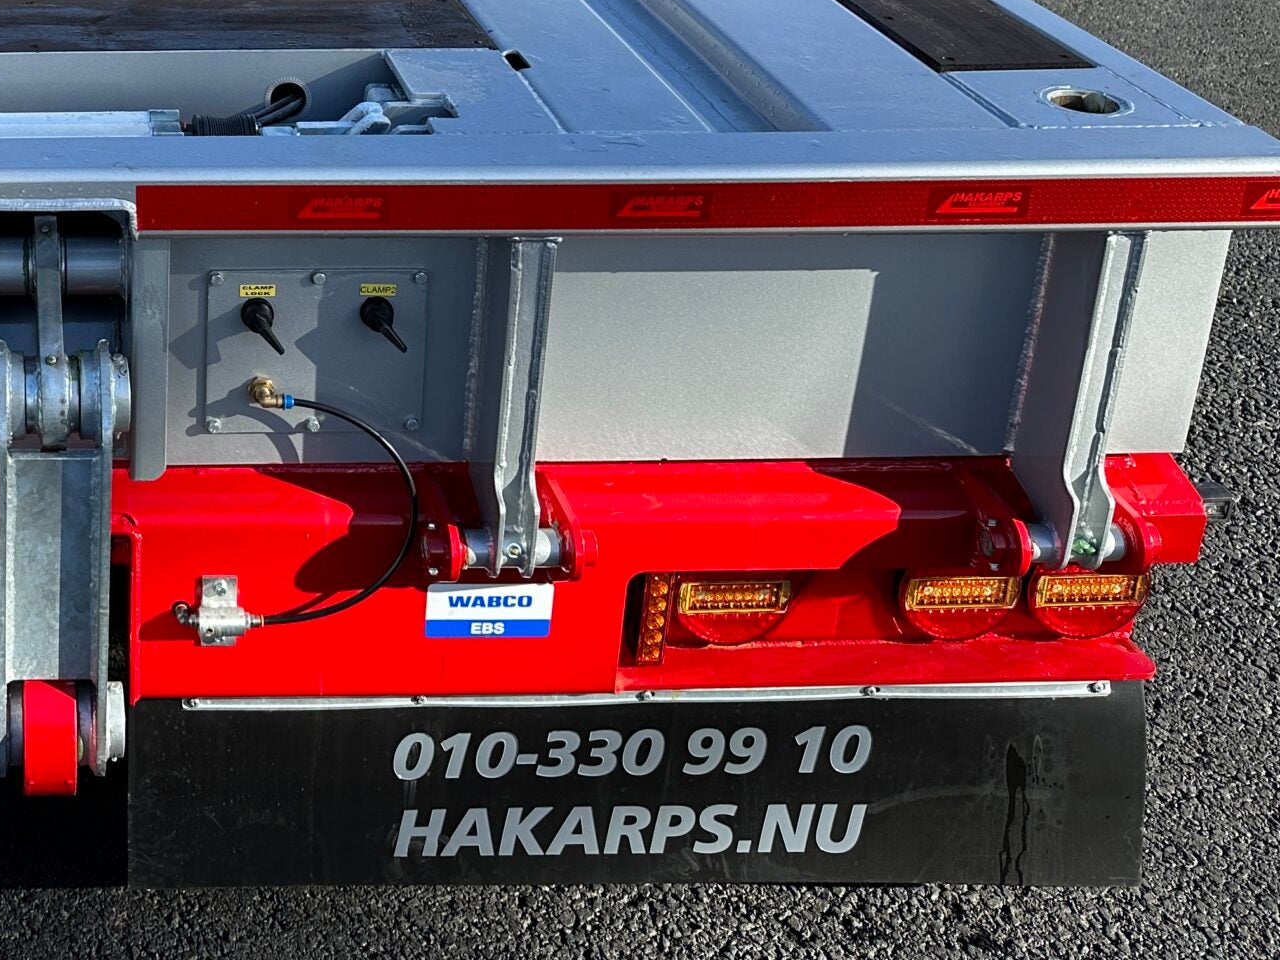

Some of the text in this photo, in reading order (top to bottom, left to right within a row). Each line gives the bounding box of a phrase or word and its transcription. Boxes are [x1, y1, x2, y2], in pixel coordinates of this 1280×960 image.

[952, 191, 1023, 202] HAKARPS
[359, 286, 397, 295] CLAMP2
[448, 595, 533, 608] WABCO
[470, 622, 505, 635] EBS
[393, 724, 873, 781] 010-330 99 10
[393, 803, 869, 858] HAKARPS.NU
